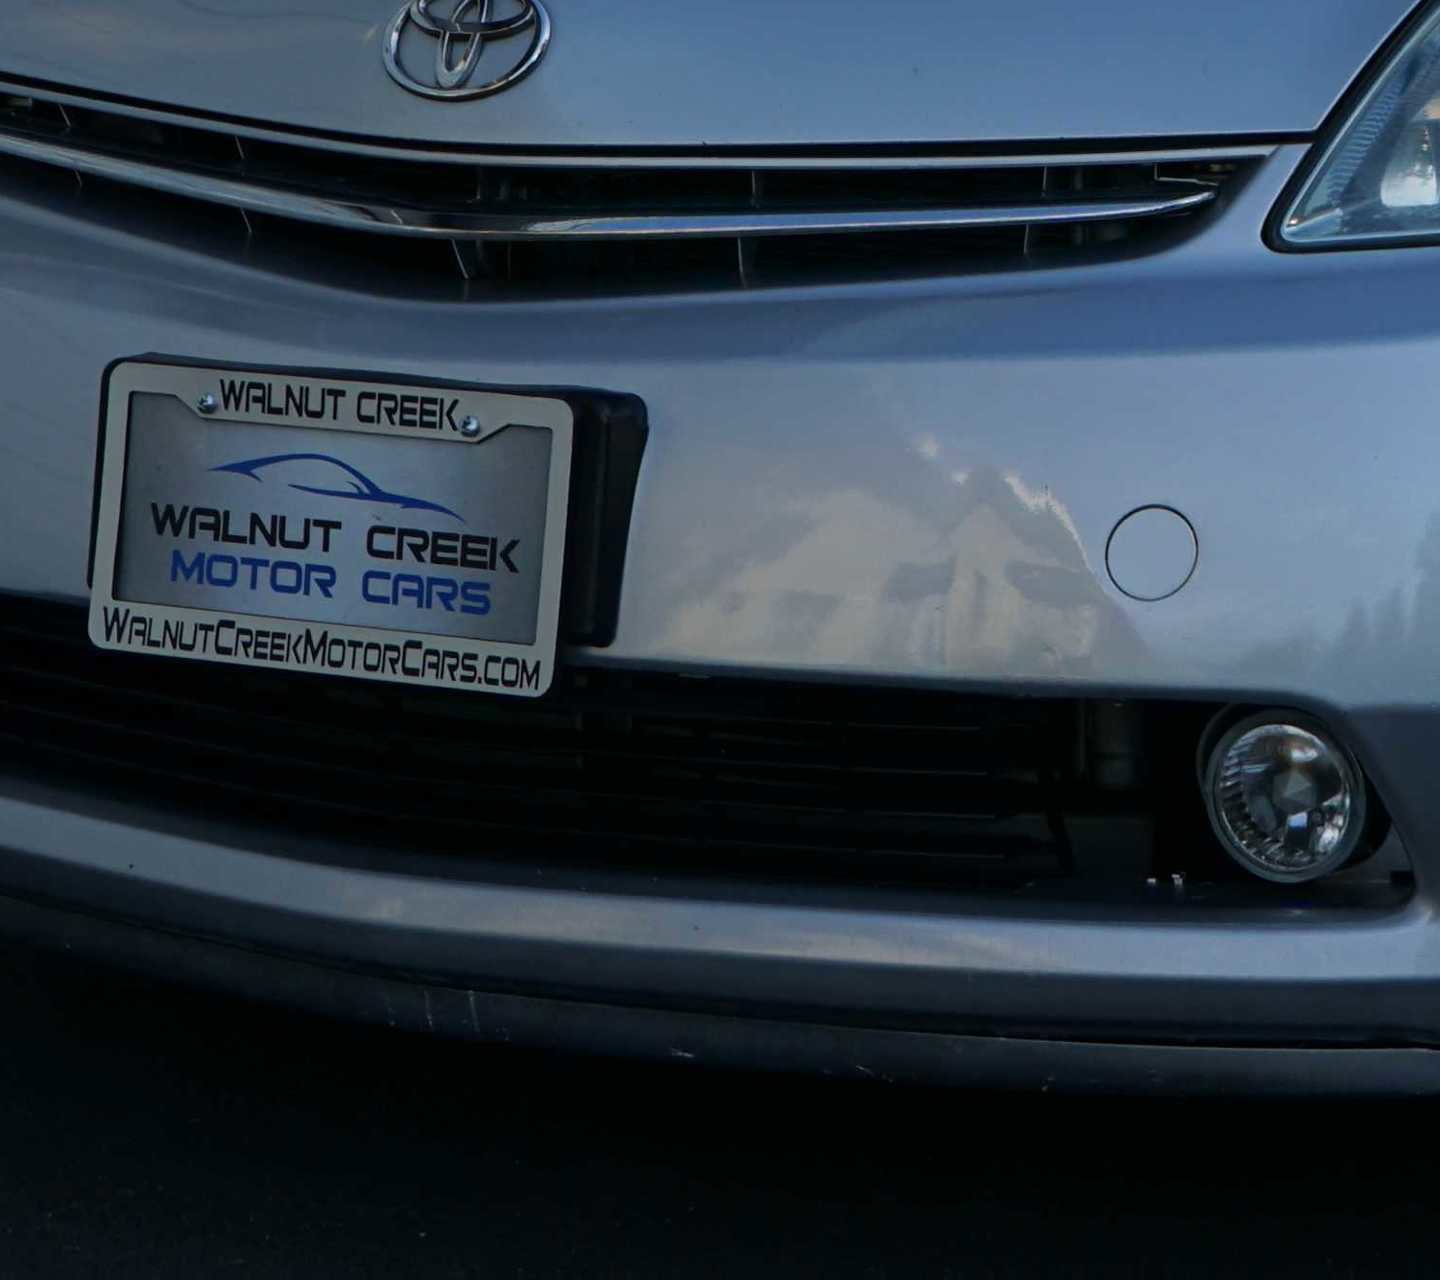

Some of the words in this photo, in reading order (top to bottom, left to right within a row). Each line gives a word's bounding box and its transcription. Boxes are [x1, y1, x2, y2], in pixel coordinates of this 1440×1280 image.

[219, 378, 346, 422] WALNUT
[355, 392, 460, 433] CREEK
[150, 501, 342, 554] WALNUT
[366, 523, 520, 575] CREEK
[170, 549, 337, 599] MOTOR
[361, 570, 492, 617] CARS
